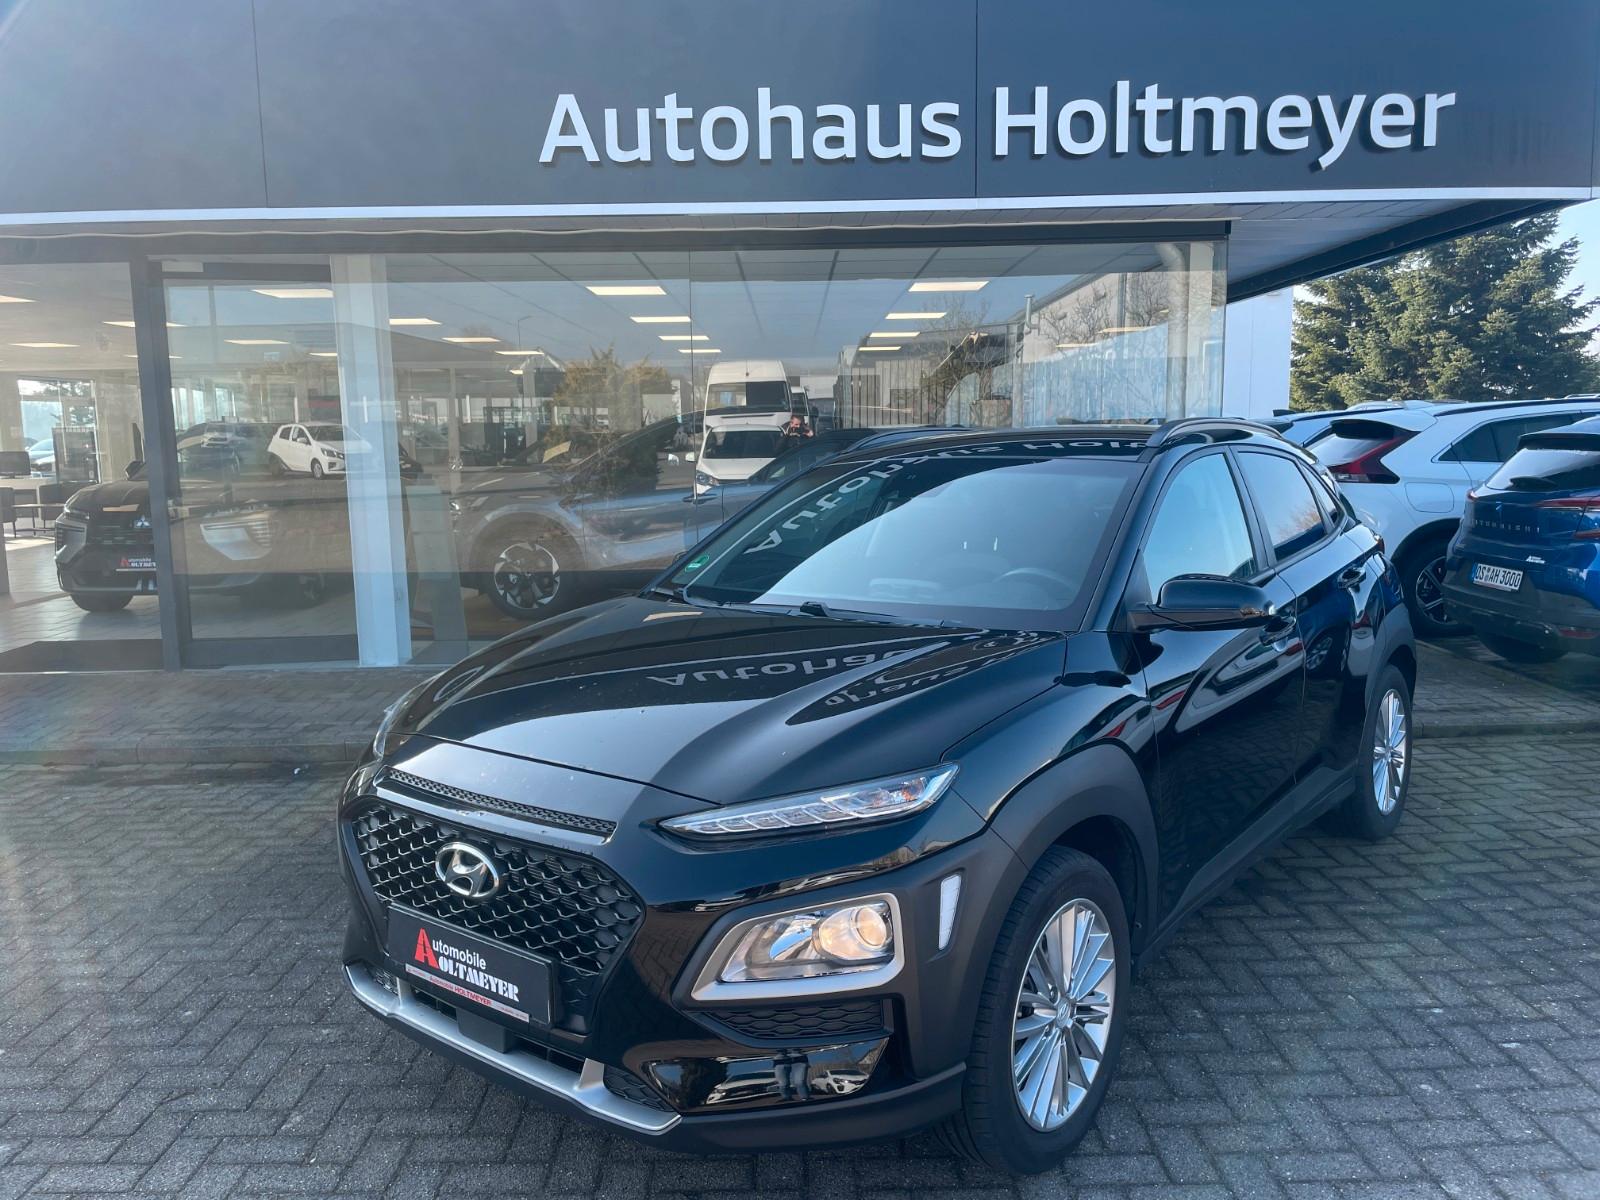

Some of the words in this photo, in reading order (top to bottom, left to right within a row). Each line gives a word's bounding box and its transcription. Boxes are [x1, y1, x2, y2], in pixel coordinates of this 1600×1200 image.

[539, 87, 962, 164] Autohaus
[994, 80, 1458, 171] Holtmeyer
[1500, 570, 1522, 588] 3000
[414, 928, 486, 969] Automobile
